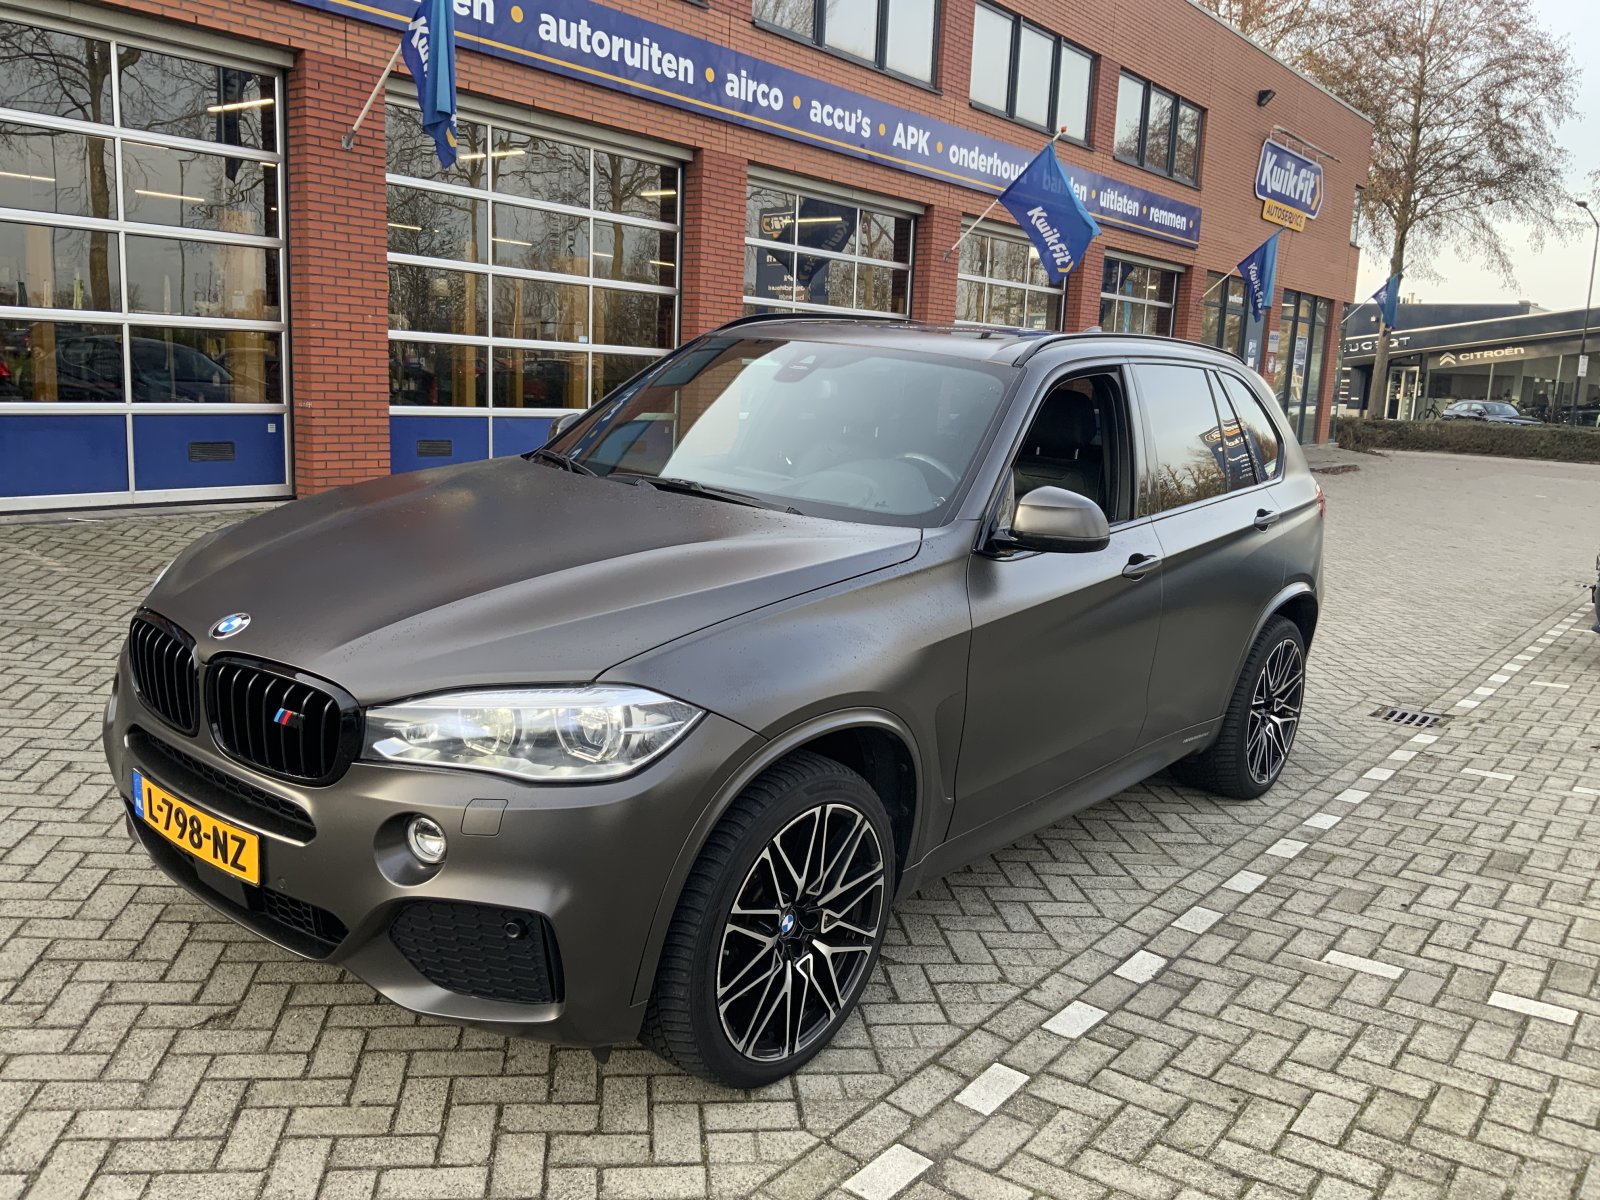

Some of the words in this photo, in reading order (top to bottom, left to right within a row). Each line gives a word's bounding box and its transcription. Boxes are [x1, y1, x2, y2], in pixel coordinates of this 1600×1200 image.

[538, 13, 694, 84] autoruiten
[725, 70, 784, 111] airco
[809, 100, 871, 138] accu's
[892, 122, 931, 156] APK
[1099, 188, 1139, 216] uitlaten
[1149, 206, 1187, 230] remmen
[1265, 204, 1304, 227] AUTOSERVICE
[147, 787, 247, 873] L-798-NZ
